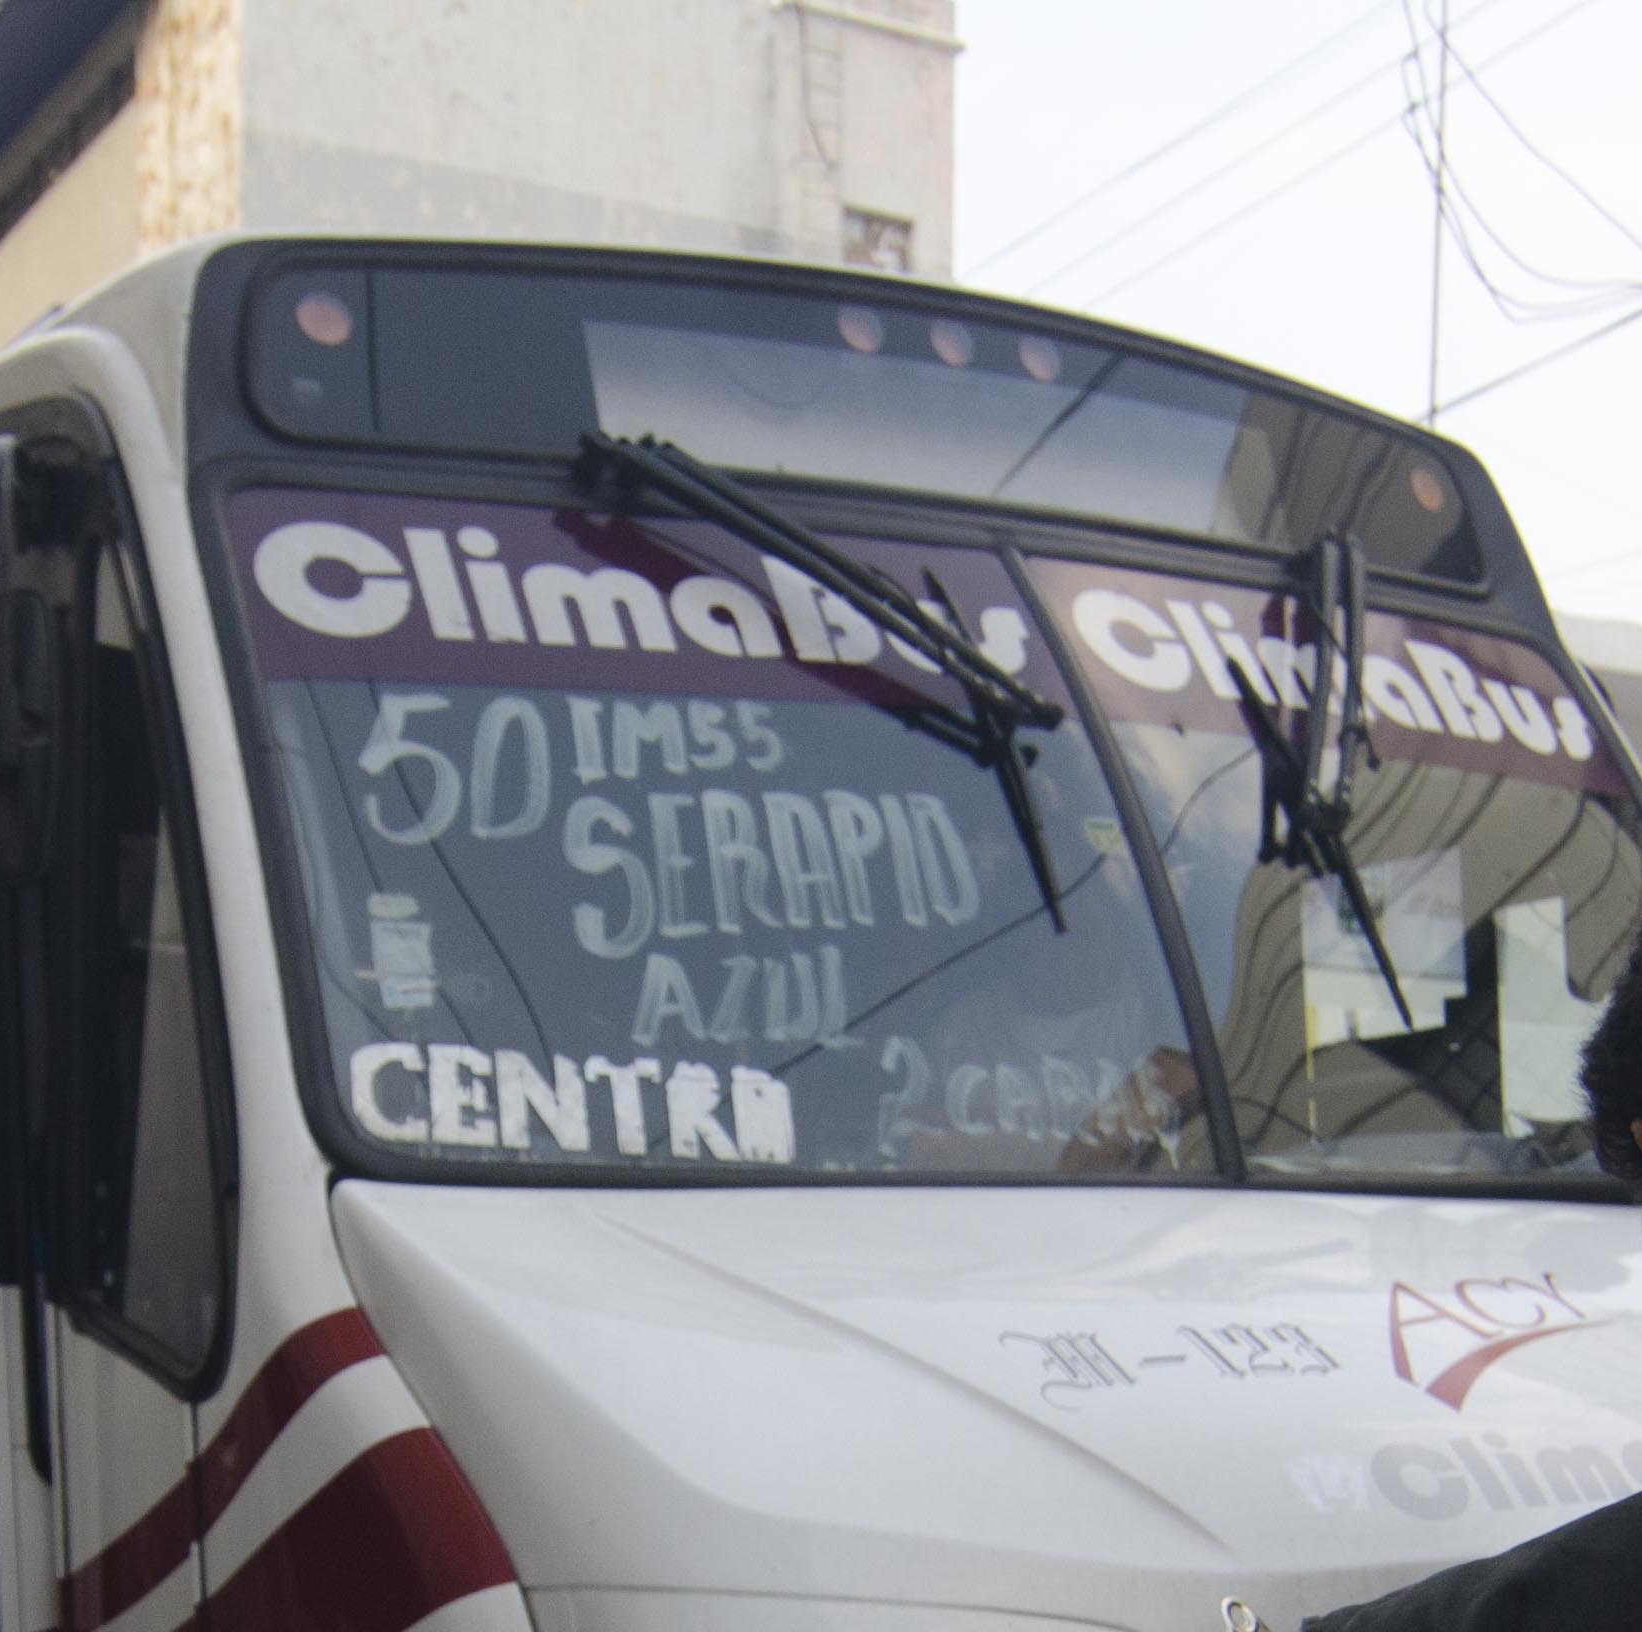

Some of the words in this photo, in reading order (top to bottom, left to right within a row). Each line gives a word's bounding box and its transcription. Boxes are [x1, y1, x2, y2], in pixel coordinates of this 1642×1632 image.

[359, 694, 551, 845] 50
[561, 788, 982, 960] SERAPIO
[630, 944, 869, 1050] AZUL
